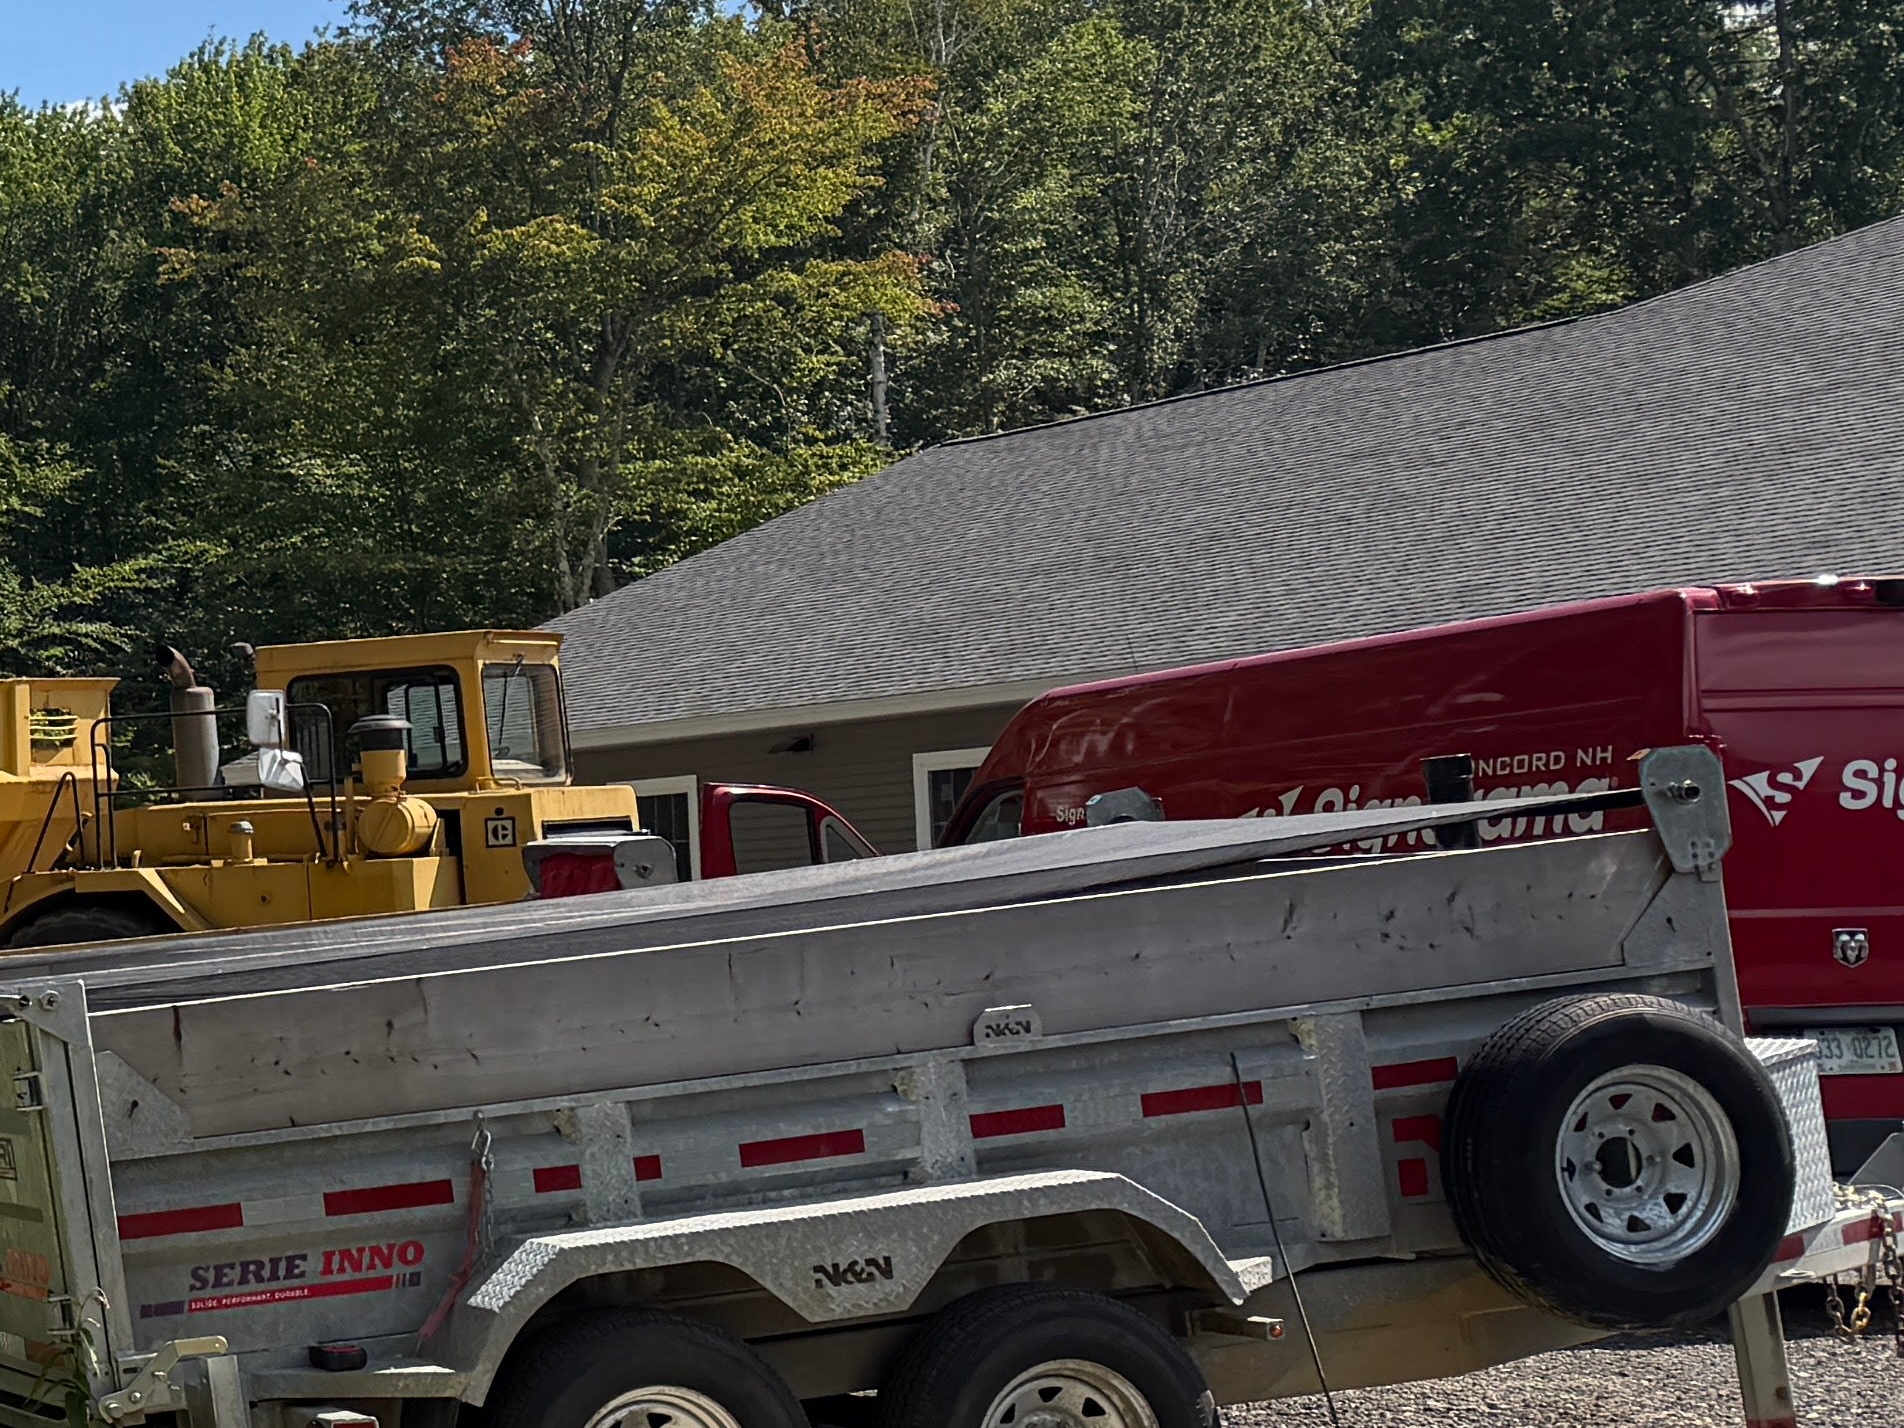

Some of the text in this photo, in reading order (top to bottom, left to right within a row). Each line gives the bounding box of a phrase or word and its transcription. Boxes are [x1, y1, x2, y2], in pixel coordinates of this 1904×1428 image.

[1471, 745, 1614, 778] NCORD NH
[1851, 1035, 1896, 1060] 0272
[188, 1239, 426, 1293] SERIE INNO
